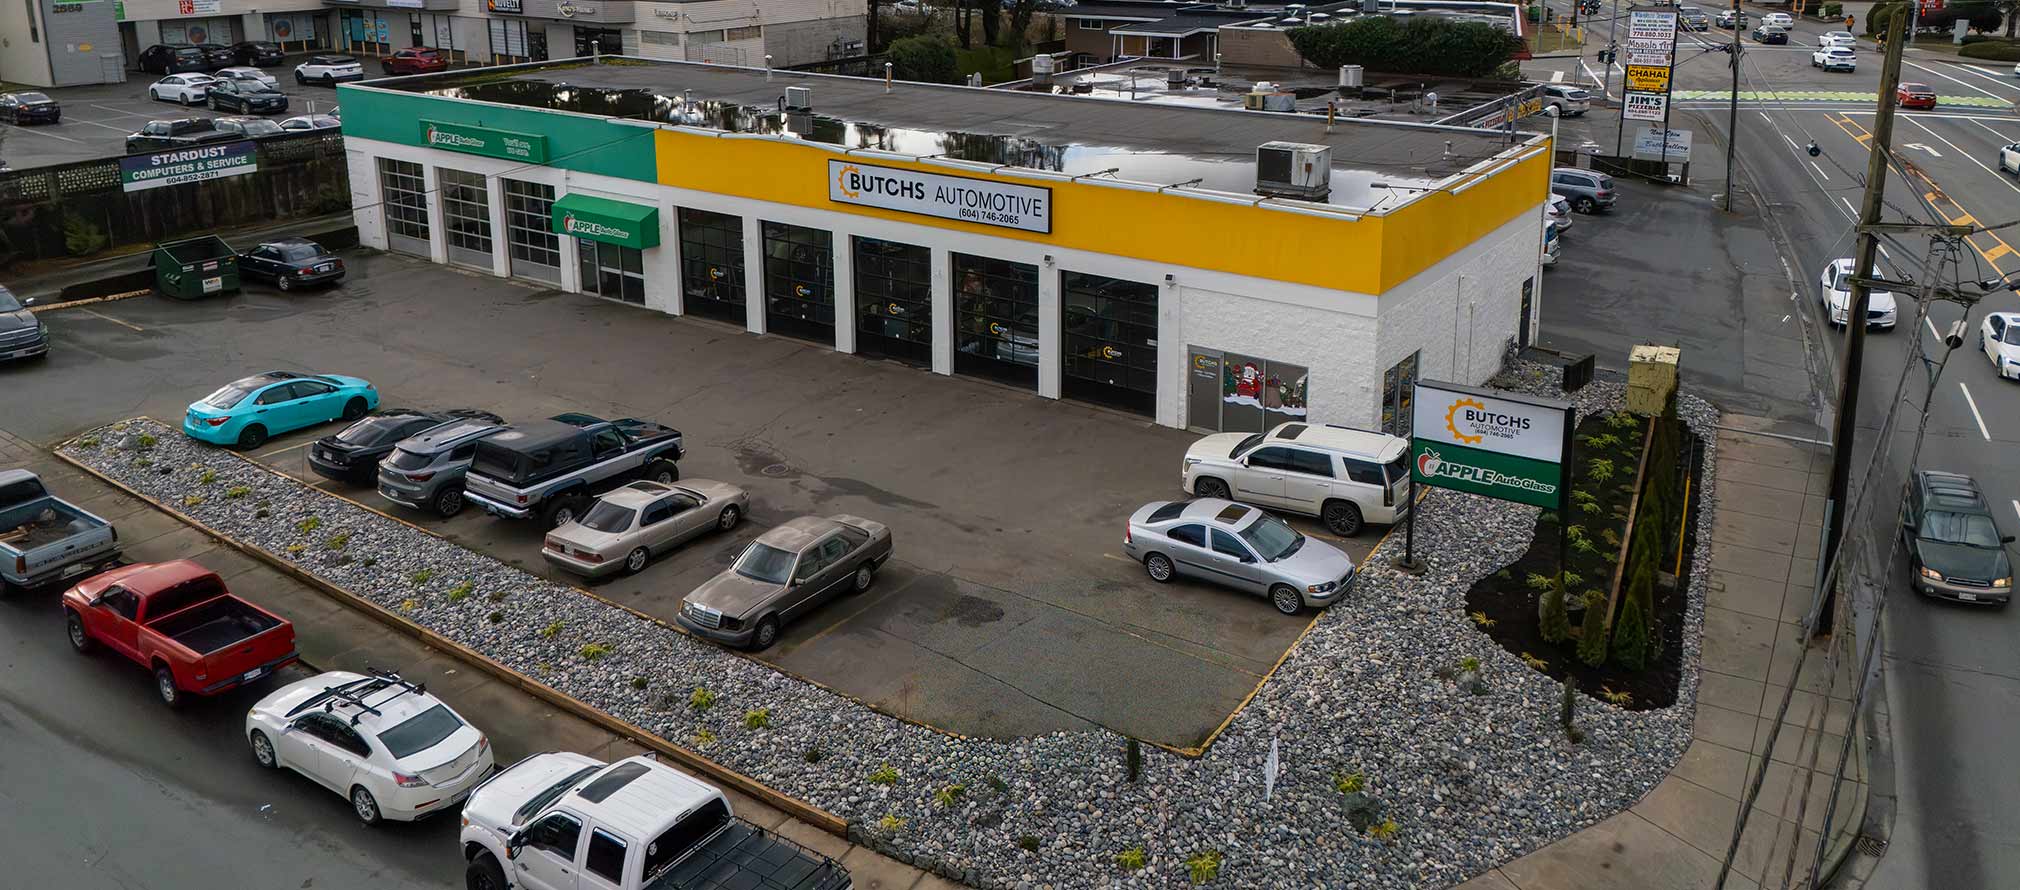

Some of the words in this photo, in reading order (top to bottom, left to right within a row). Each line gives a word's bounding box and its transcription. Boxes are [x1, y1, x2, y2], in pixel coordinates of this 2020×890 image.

[1628, 69, 1668, 79] CHAHAL
[1628, 95, 1662, 106] JIM'S
[436, 131, 460, 145] APPLE
[151, 146, 227, 166] STARDUST
[132, 162, 195, 180] COMPUTERS
[196, 161, 205, 170] &
[207, 155, 248, 169] SERVICE
[850, 173, 926, 200] BUTCHS
[934, 185, 1043, 218] AUTOMOTIVE
[958, 207, 980, 220] (604)
[981, 210, 1020, 225] 746-2065
[573, 221, 601, 236] APPLE
[1465, 409, 1531, 430] BUTCHS
[1469, 422, 1521, 436] AUTOMOTIVE
[1434, 461, 1495, 484] APPLE
